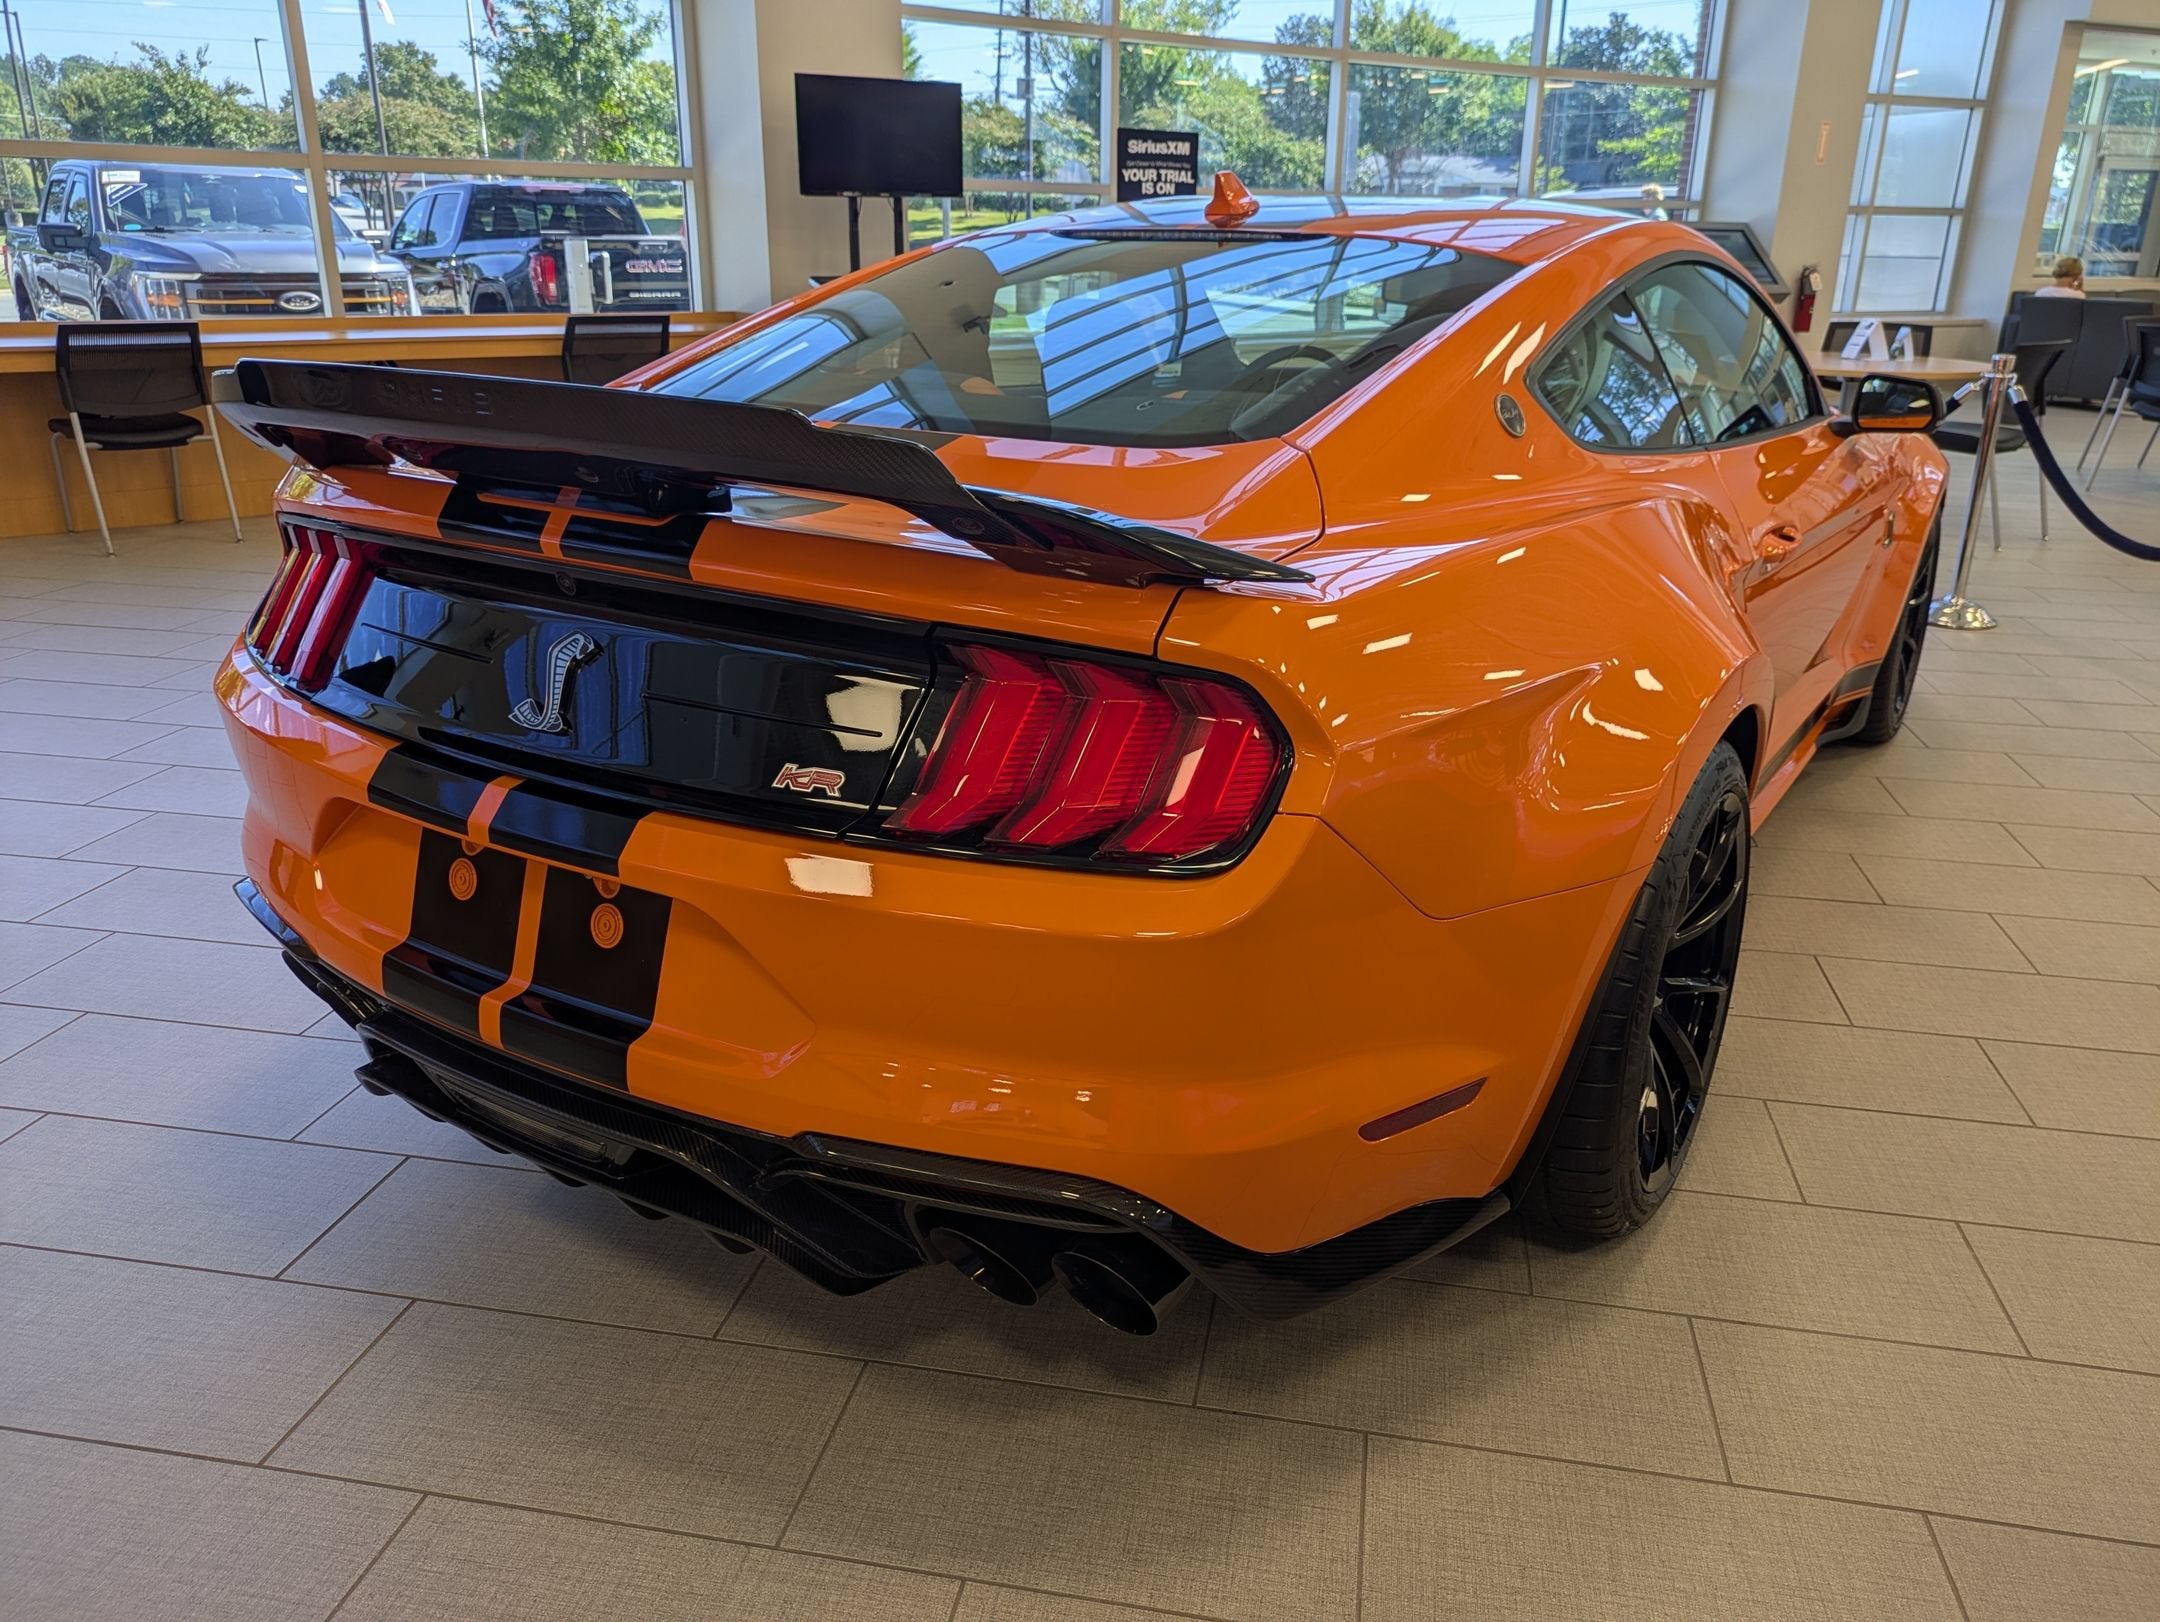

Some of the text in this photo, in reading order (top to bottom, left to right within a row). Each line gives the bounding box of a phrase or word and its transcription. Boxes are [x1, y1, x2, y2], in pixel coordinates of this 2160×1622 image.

[1127, 139, 1190, 155] SiriusXM
[1121, 168, 1194, 184] YOUR TRIAL
[1142, 182, 1175, 195] IS ON
[625, 259, 682, 273] GMC
[771, 763, 845, 797] KR
